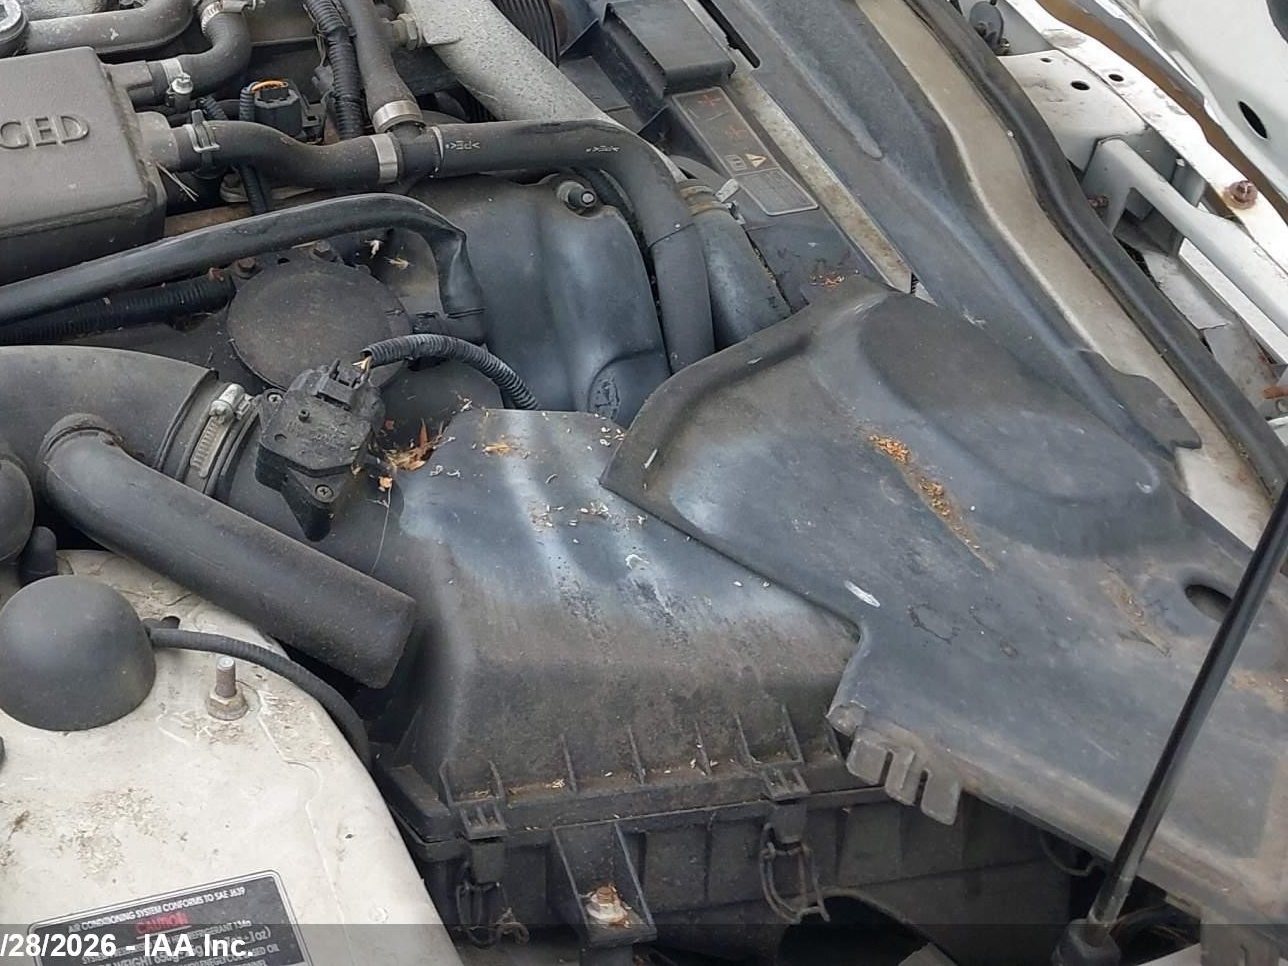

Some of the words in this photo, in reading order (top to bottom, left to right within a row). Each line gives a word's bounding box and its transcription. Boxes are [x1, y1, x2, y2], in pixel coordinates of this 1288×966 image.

[81, 911, 136, 931] CONDITIONING
[135, 905, 162, 919] SYSTEM
[162, 897, 204, 913] CONFORMS
[203, 893, 214, 903] TO
[214, 890, 230, 901] SAE
[136, 911, 189, 934] CAUTION
